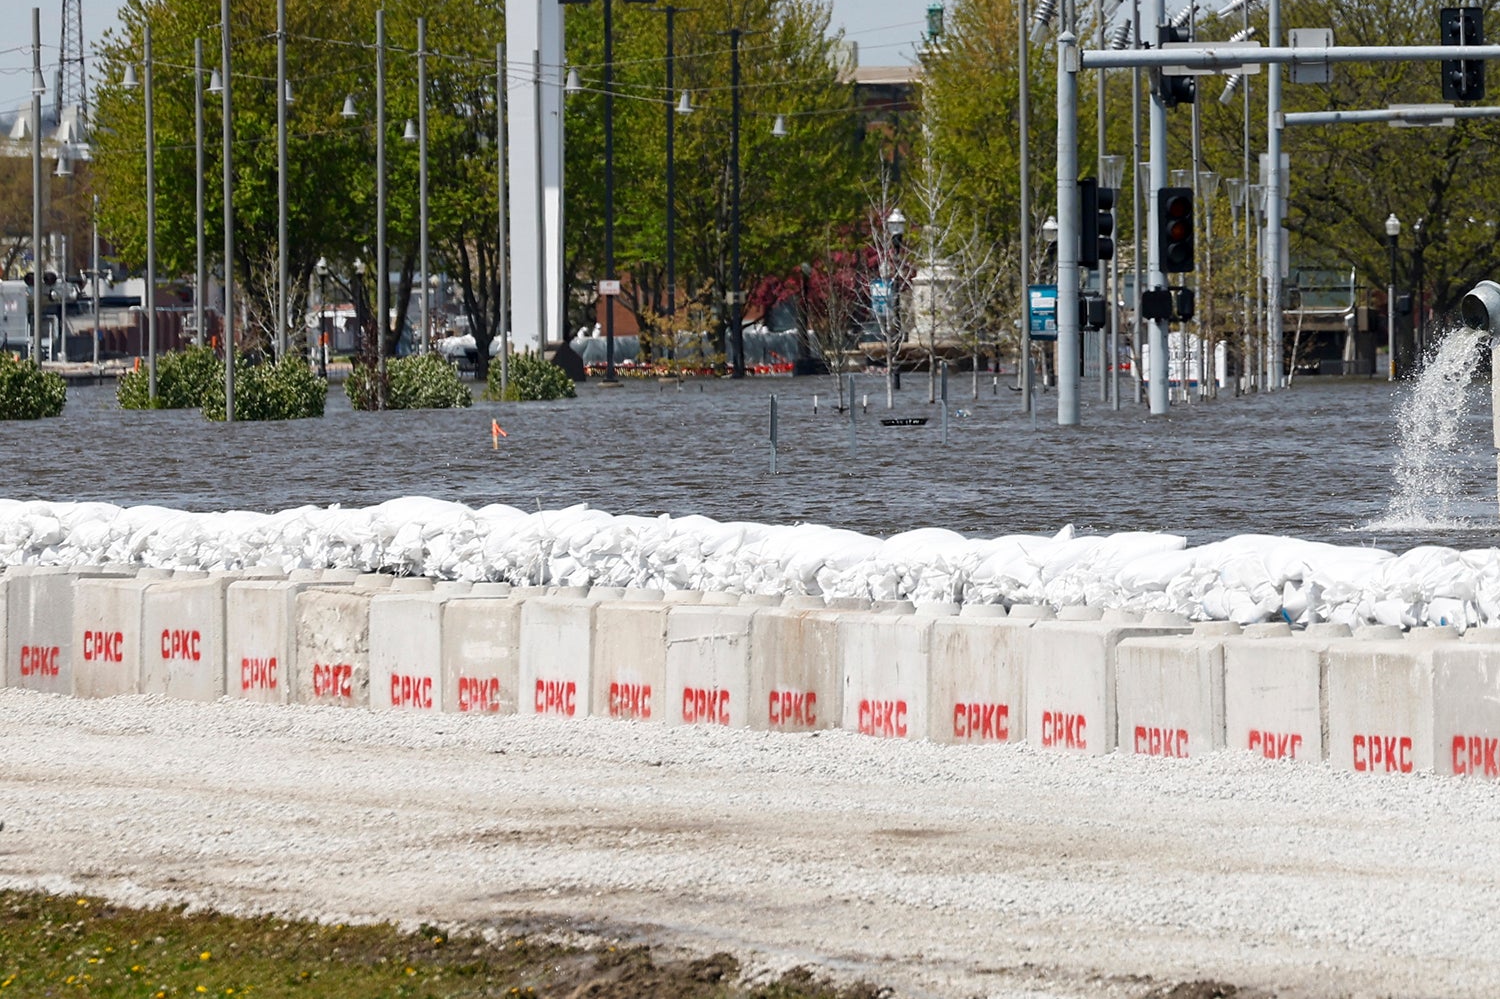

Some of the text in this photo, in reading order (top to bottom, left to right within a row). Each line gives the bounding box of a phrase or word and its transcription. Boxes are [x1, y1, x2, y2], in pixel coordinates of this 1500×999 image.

[22, 646, 60, 677] CPKC
[84, 631, 124, 663] CPKC
[162, 630, 201, 661] CPKC
[242, 658, 277, 690] CPKC
[391, 675, 432, 708] CPKC
[459, 678, 500, 712] CPKC
[536, 680, 576, 716] CPKC
[610, 683, 652, 718] CPKC
[684, 688, 730, 725] CPKC
[770, 691, 817, 726] CPKC
[859, 700, 907, 737] CPKC
[955, 704, 1009, 740] CPKC
[1043, 712, 1087, 749] CPKC
[1136, 727, 1189, 757] CPKC
[1354, 735, 1413, 773] CPKC
